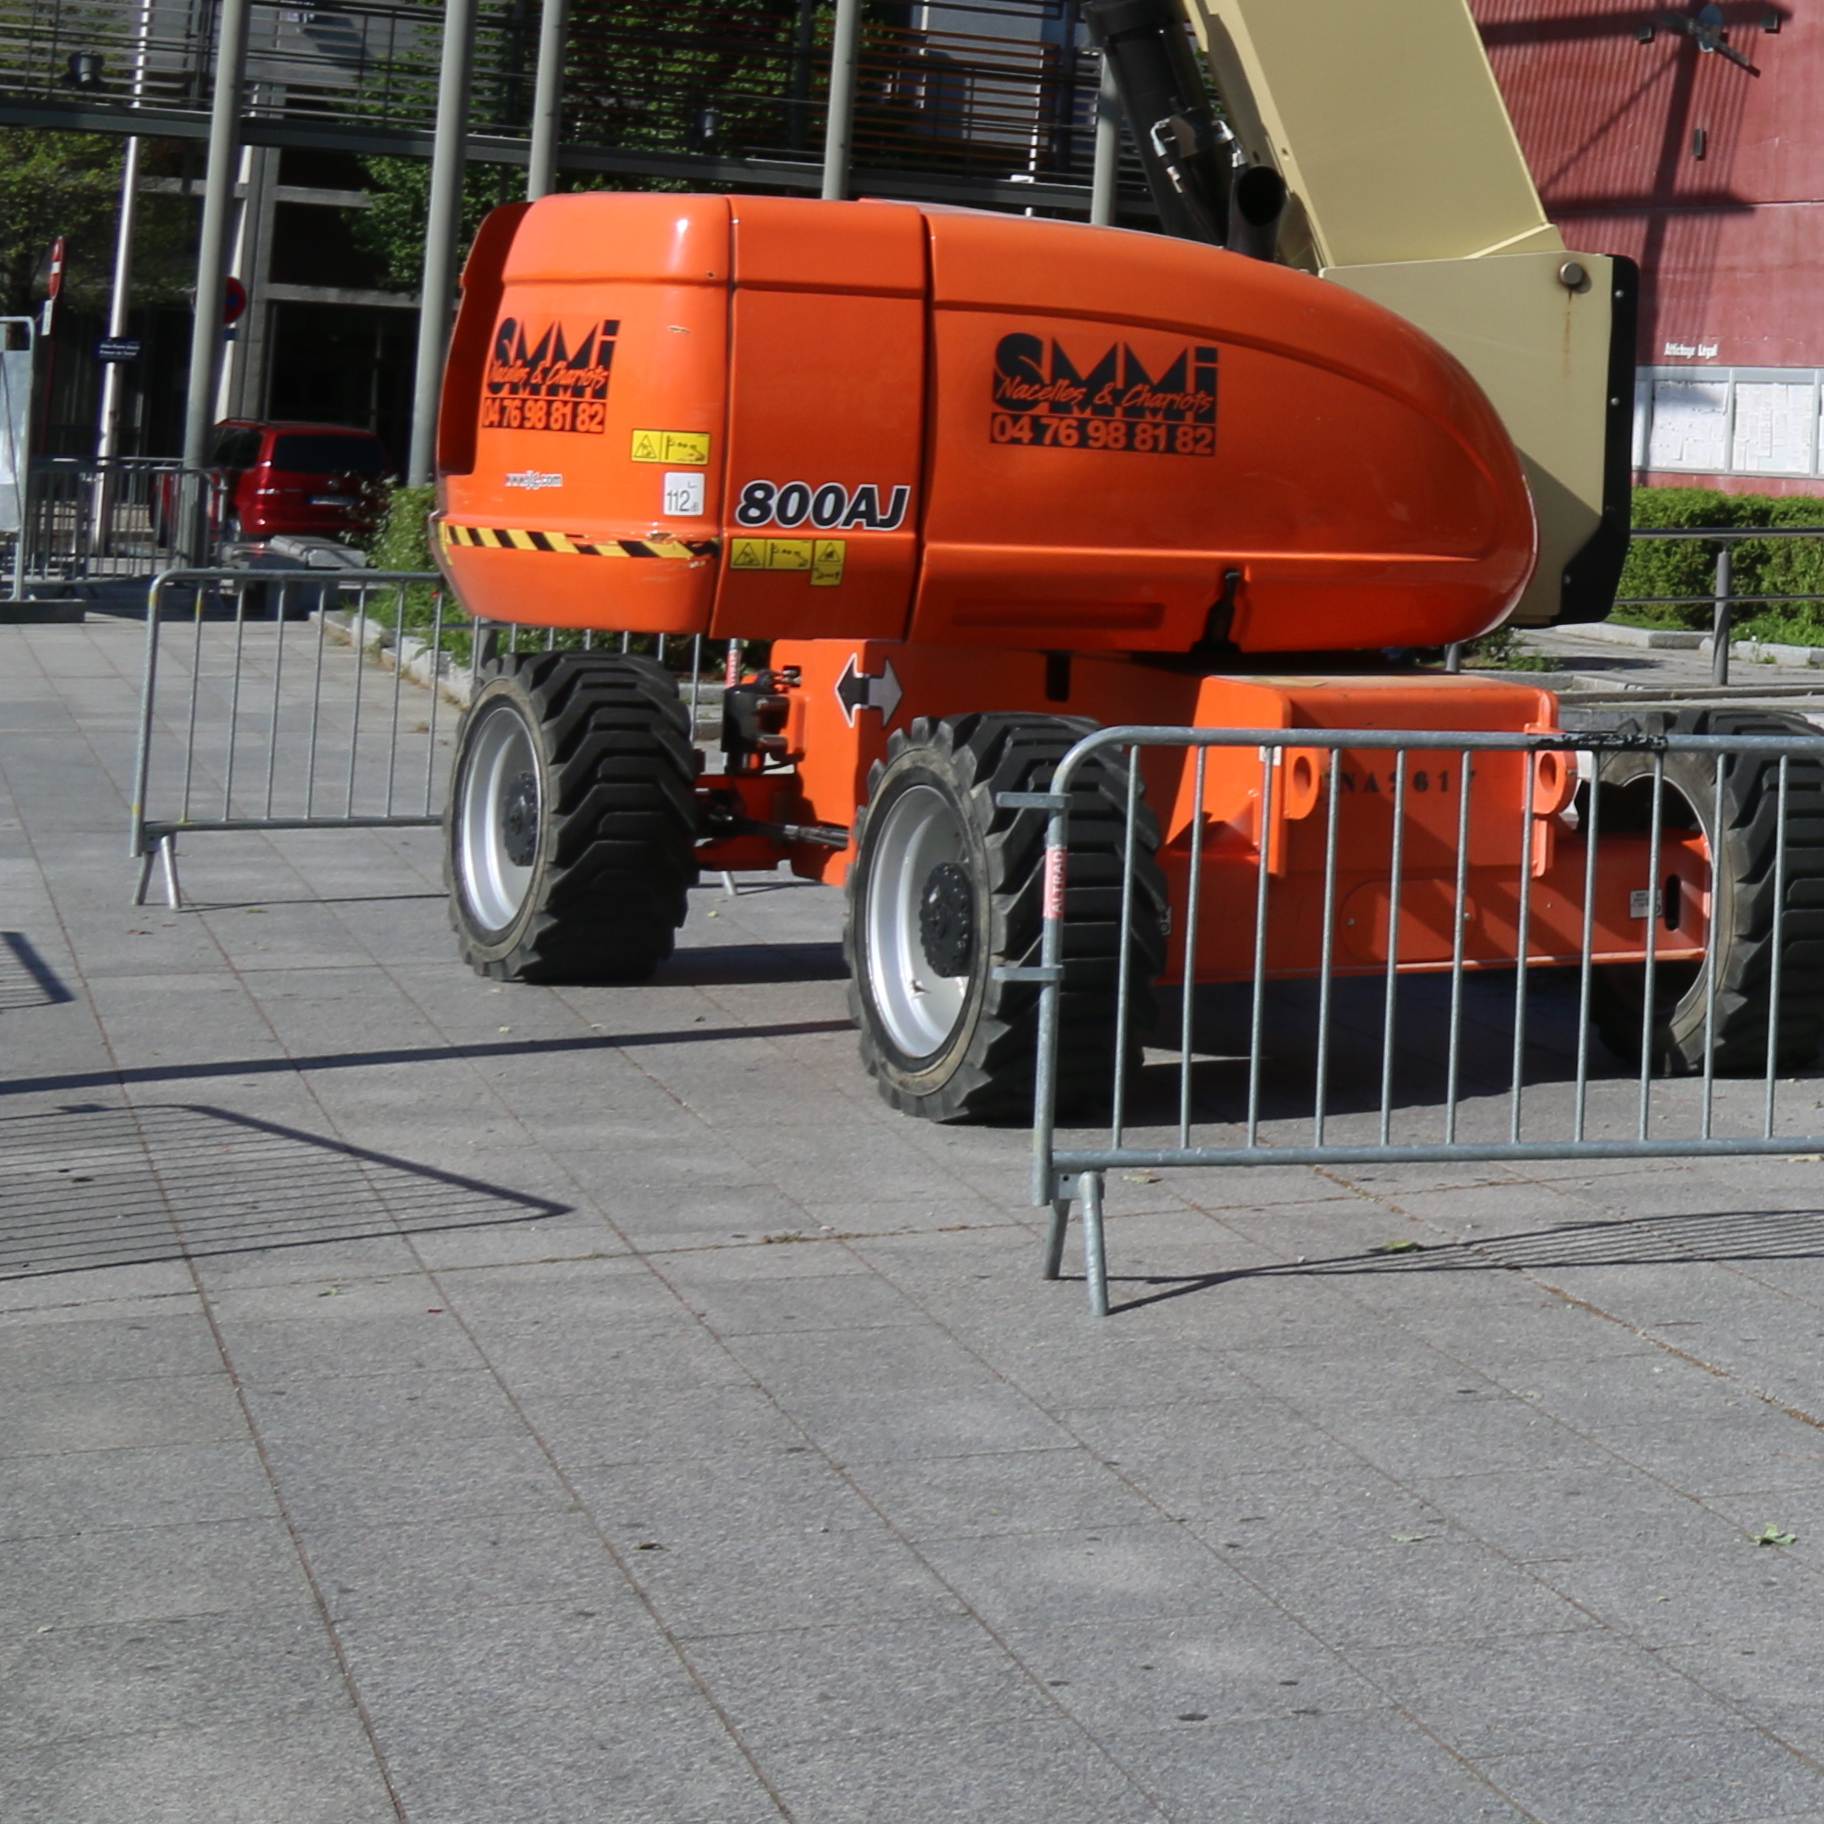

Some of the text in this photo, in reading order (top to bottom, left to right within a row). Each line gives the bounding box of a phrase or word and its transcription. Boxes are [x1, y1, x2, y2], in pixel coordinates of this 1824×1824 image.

[996, 375, 1214, 414] Nacelles & Chariots
[483, 398, 604, 433] 04 76 98 81 82
[992, 414, 1213, 454] 04 76 98 81 82
[666, 490, 691, 512] 112
[735, 479, 911, 530] 800AJ
[1052, 851, 1064, 913] ALTRAD
